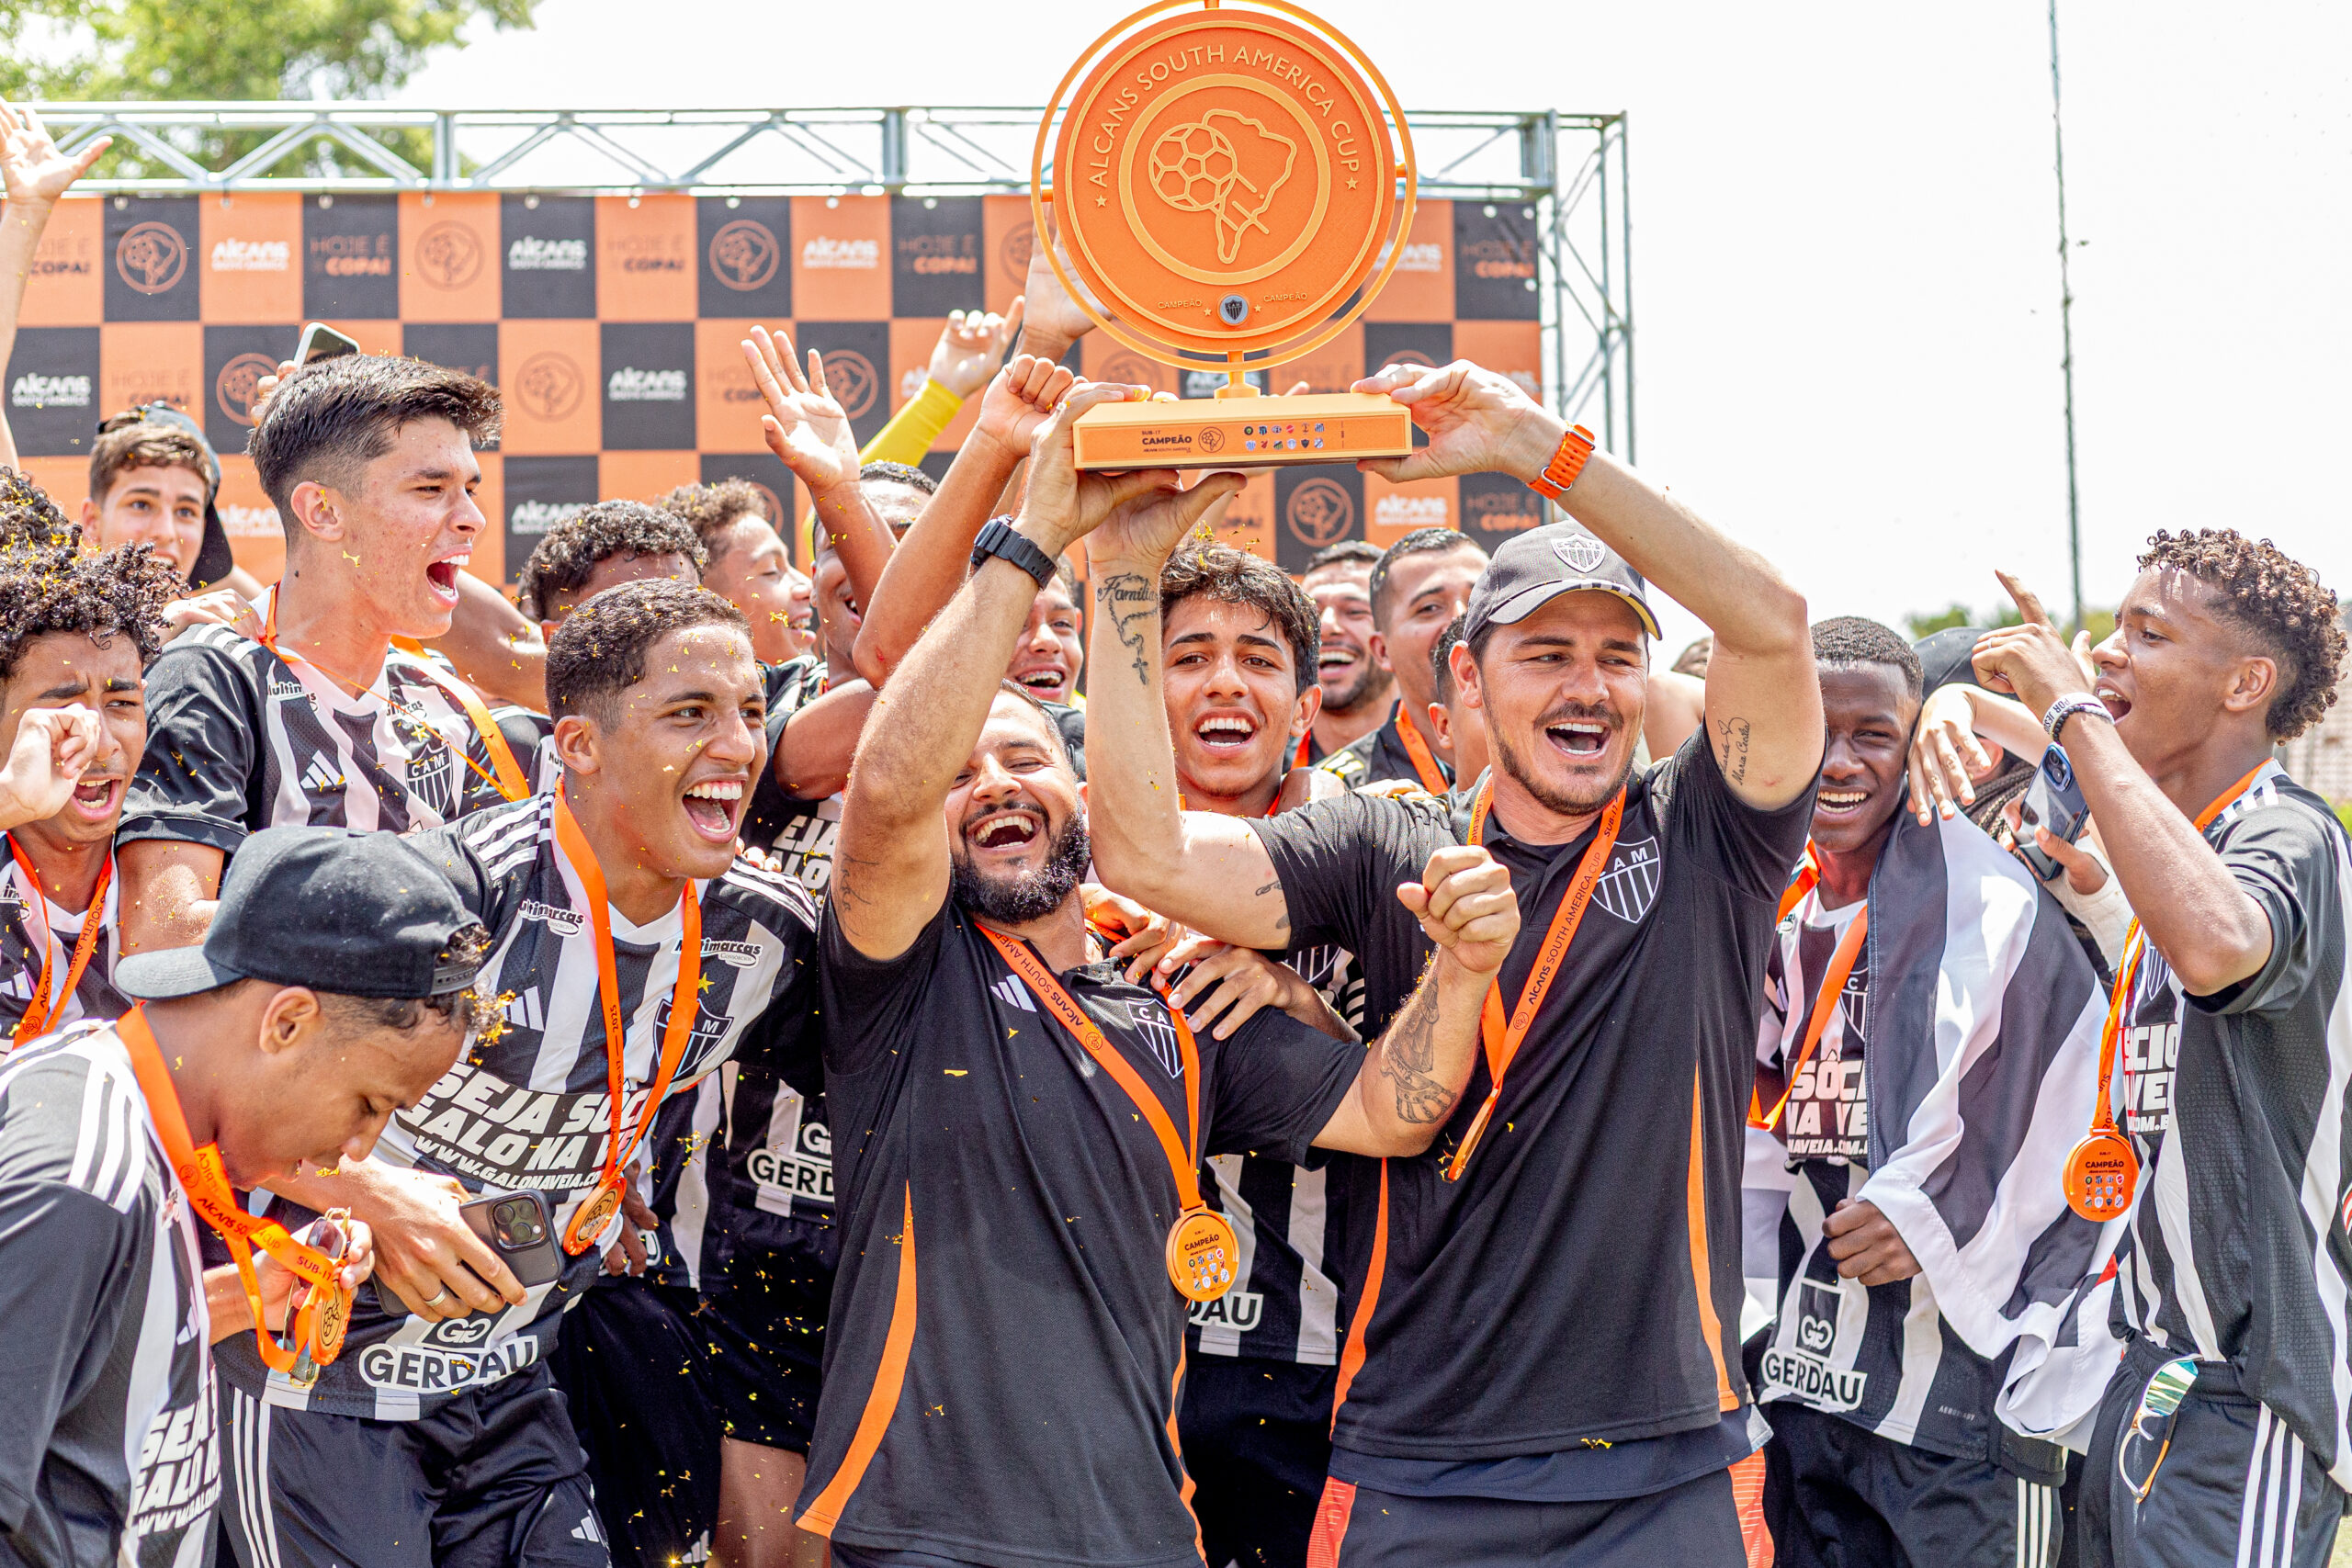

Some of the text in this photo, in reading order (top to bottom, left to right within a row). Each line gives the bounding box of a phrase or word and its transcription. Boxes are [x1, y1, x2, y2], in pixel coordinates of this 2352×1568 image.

[1089, 44, 1360, 188] ALCANS SOUTH AMERICA CUP
[1158, 299, 1203, 309] CAMPEÃO
[1263, 291, 1308, 302] CAMPEÃO
[1142, 434, 1193, 446] CAMPEÃO
[2052, 698, 2071, 714] POR
[412, 754, 447, 777] CAM
[1603, 803, 1618, 838] SUB-17
[1546, 925, 1570, 964] SOUTH
[1565, 875, 1593, 927] AMERICA
[1588, 852, 1602, 874] CUP
[77, 904, 103, 942] SOUTH
[1020, 957, 1053, 993] SOUTH
[609, 1004, 619, 1033] 2025
[1138, 1007, 1168, 1025] CA
[428, 1063, 559, 1134] SEJA
[524, 1136, 588, 1171] NA
[2085, 1159, 2124, 1168] CAMPEÃO
[1184, 1234, 1220, 1251] CAMPEÃO
[297, 1256, 332, 1281] SUB-17
[364, 1340, 533, 1389] GERDAU
[1765, 1352, 1861, 1404] GERDAU
